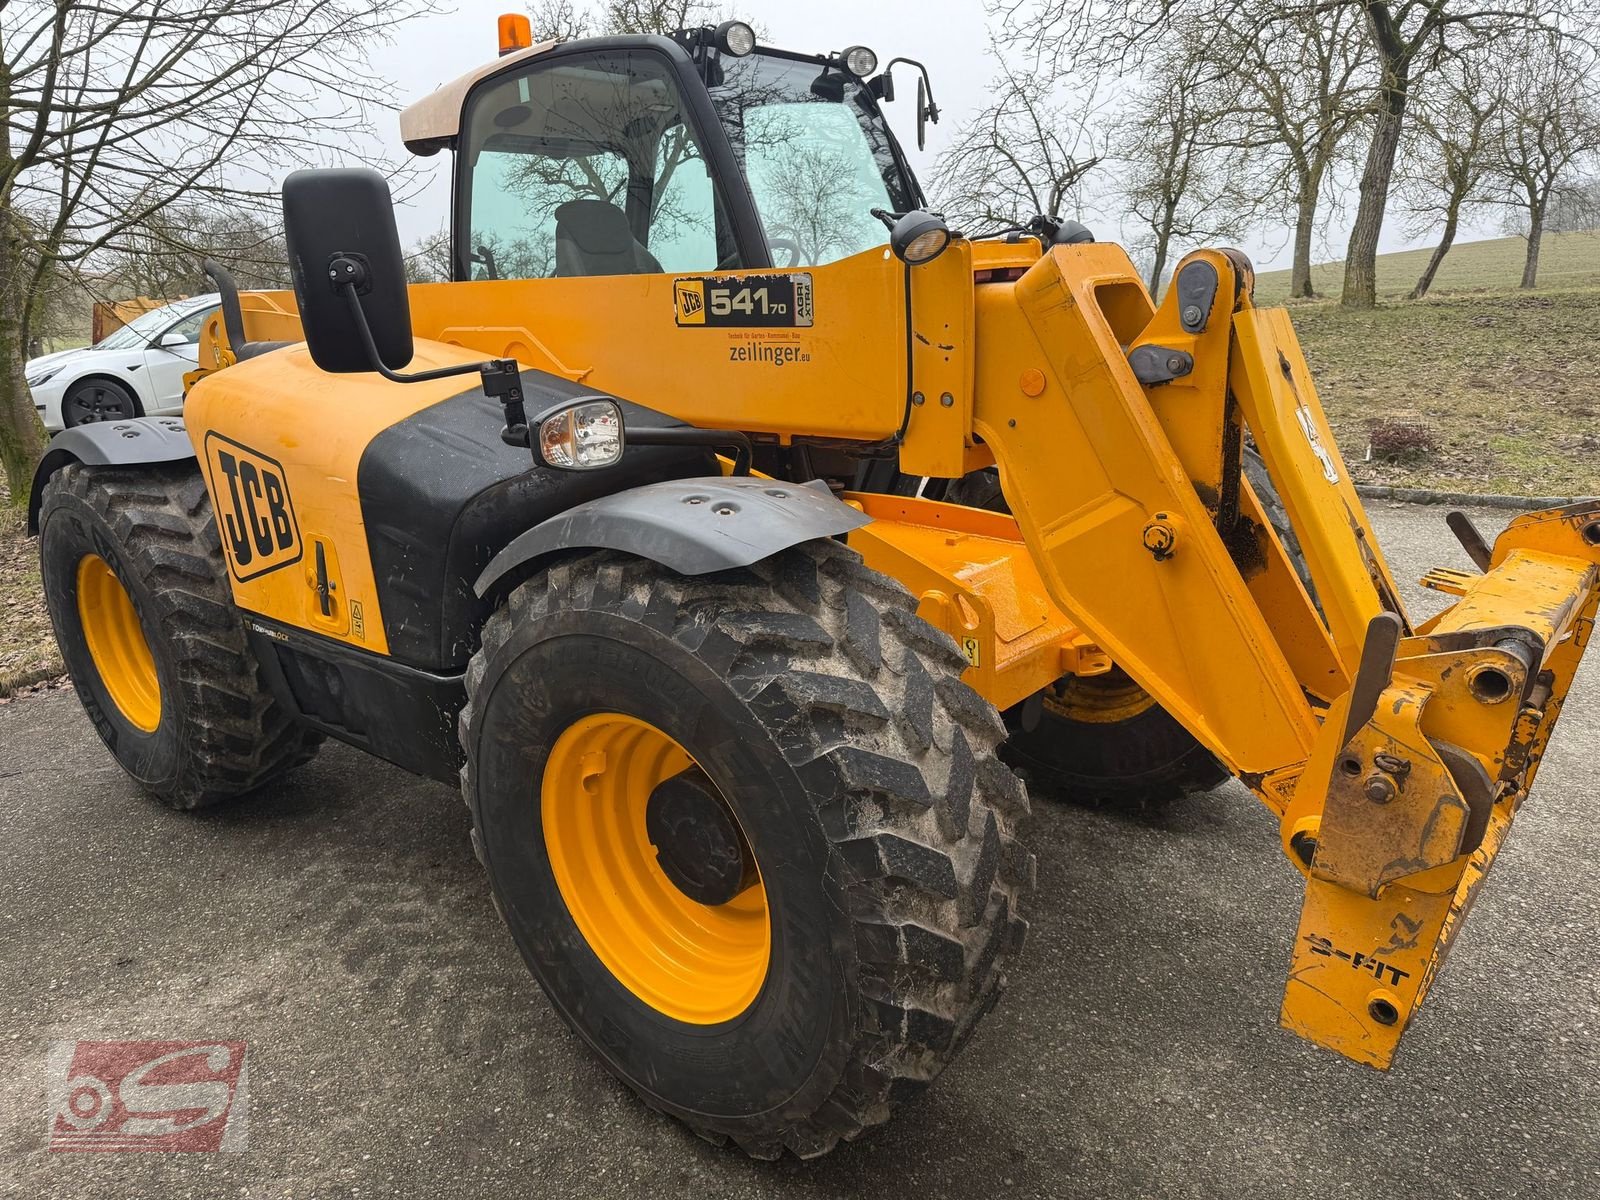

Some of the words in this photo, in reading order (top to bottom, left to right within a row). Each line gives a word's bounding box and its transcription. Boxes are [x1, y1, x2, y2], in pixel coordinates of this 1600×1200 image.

[682, 291, 702, 314] JCB
[710, 287, 768, 316] 541
[769, 303, 787, 315] 70
[796, 282, 804, 318] AGRI
[217, 449, 294, 566] JCB
